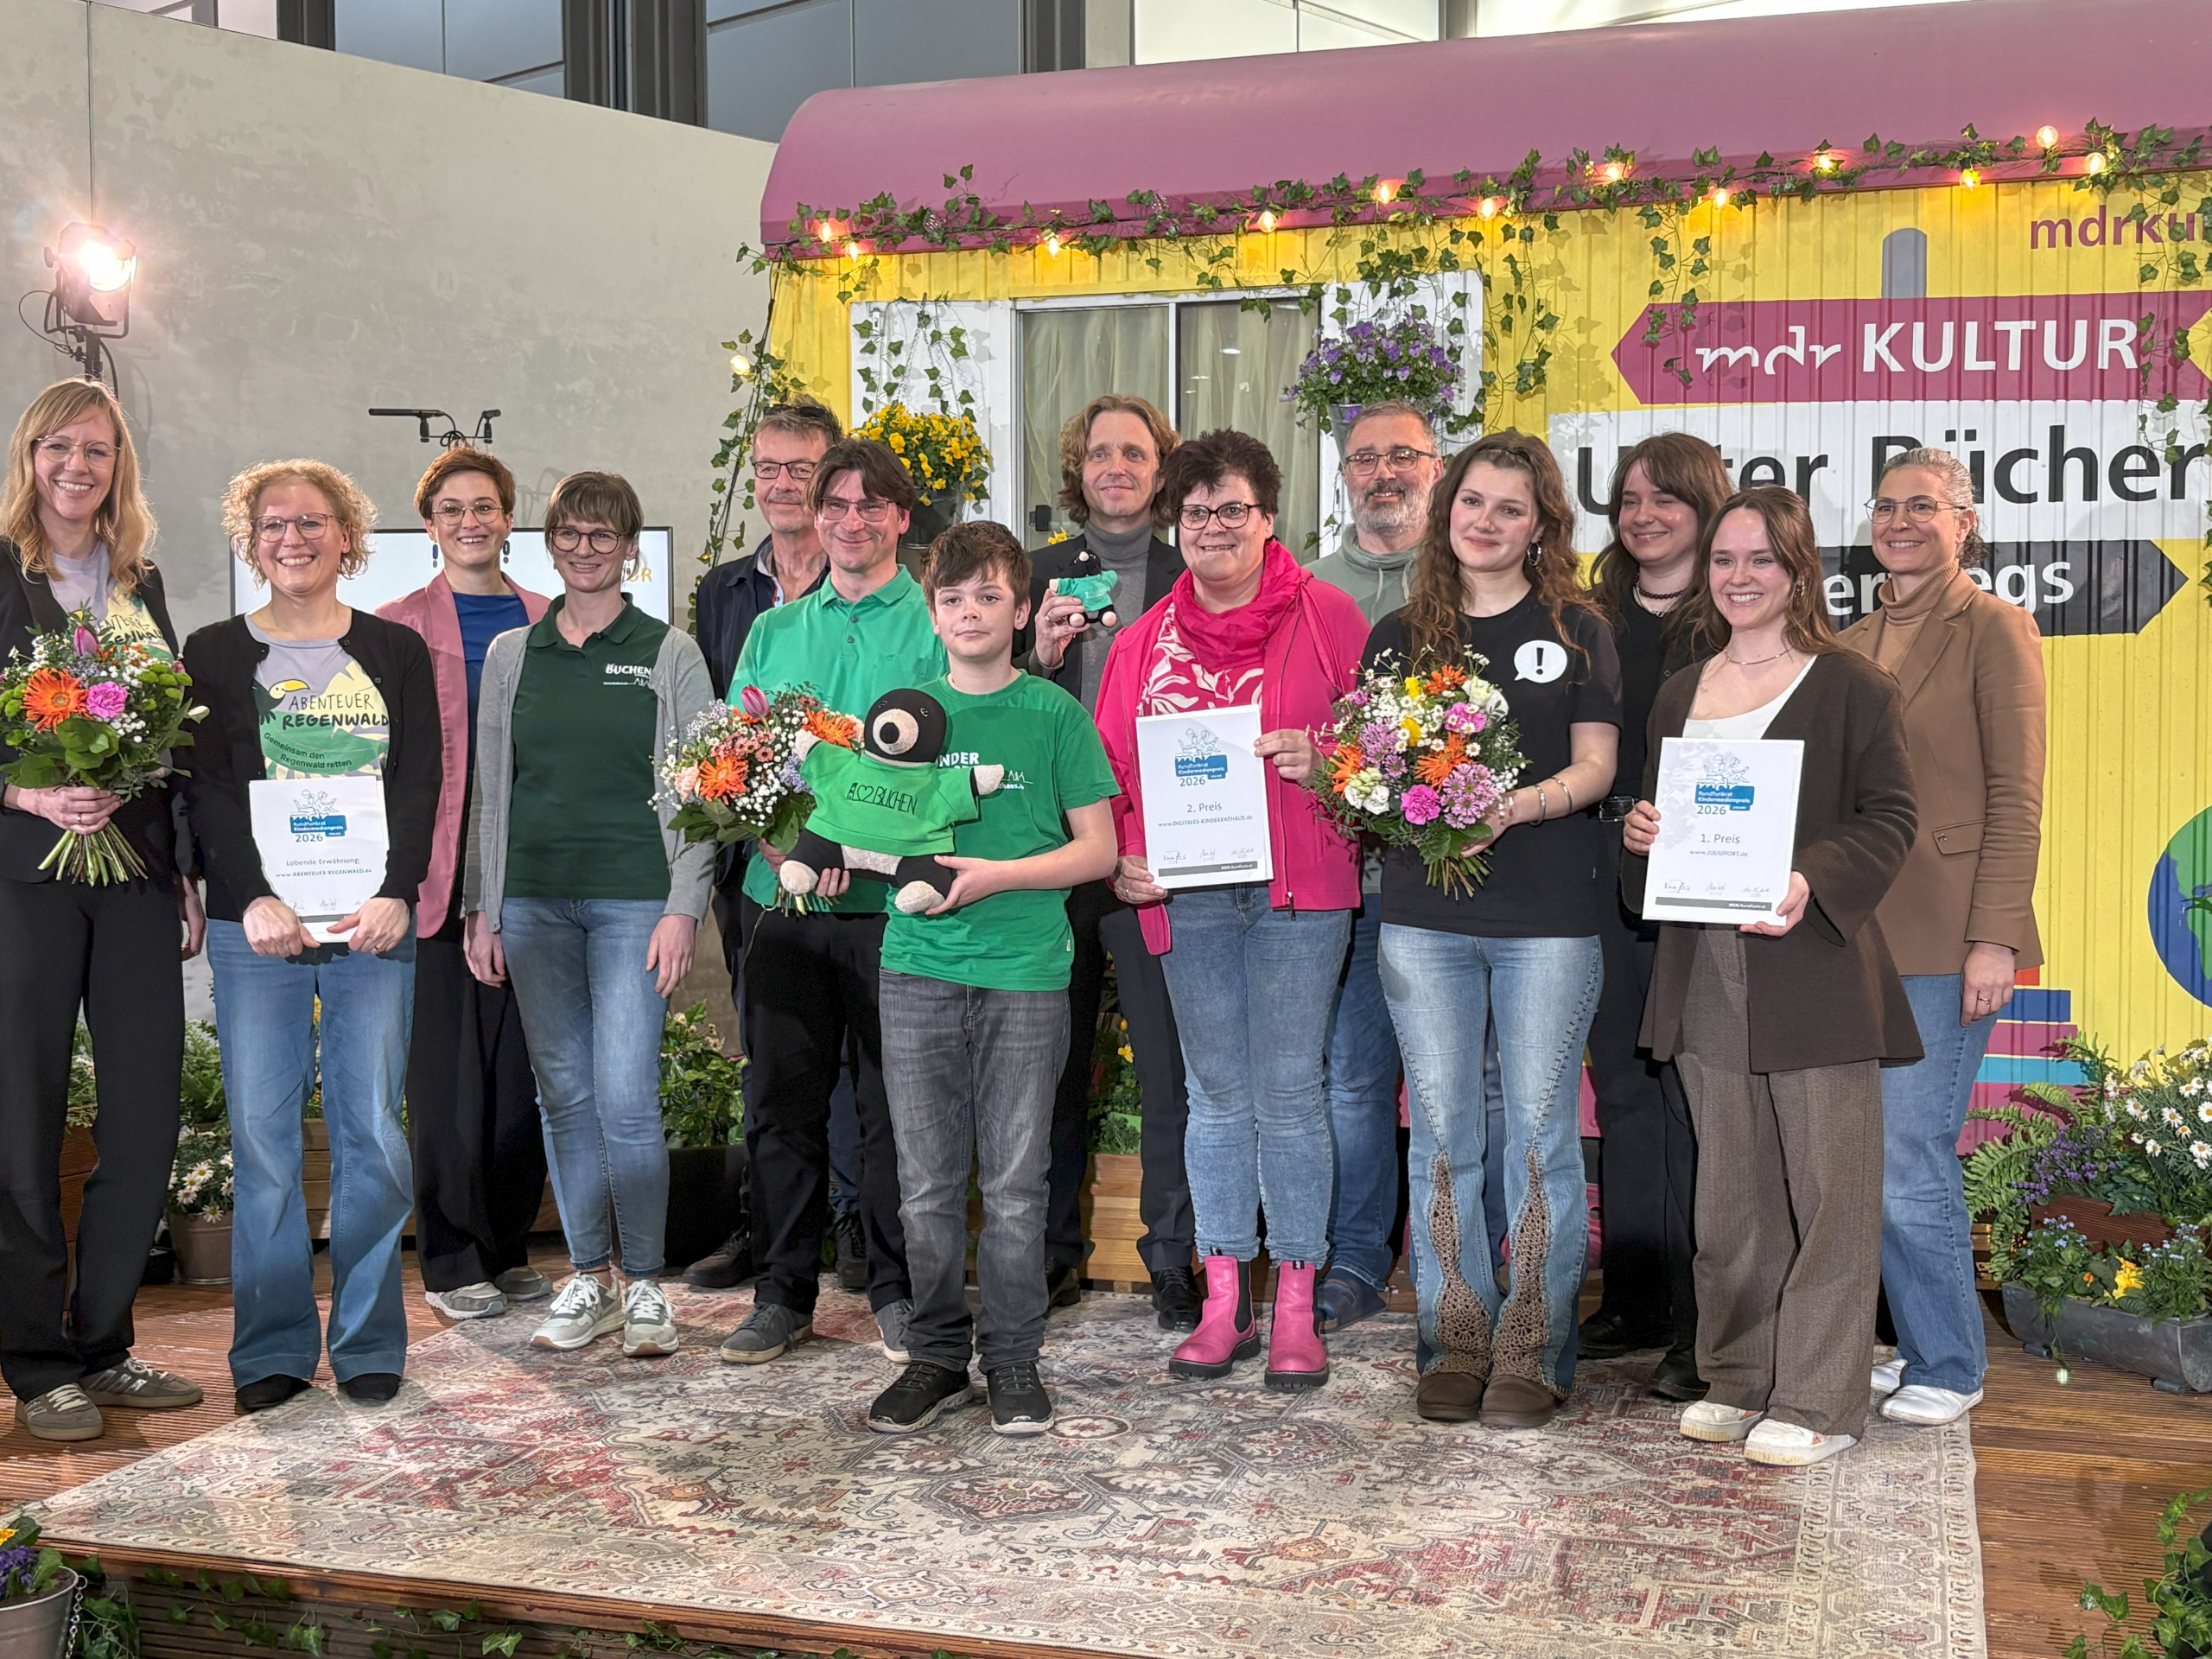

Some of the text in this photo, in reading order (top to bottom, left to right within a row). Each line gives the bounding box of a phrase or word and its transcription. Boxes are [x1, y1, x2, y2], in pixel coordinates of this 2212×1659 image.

[2031, 205, 2206, 249] mdrku
[1695, 319, 2139, 375] mdr KULTUR
[1577, 444, 1828, 515] Uer
[606, 664, 652, 676] BUCHEN
[289, 693, 374, 710] ABENTEUER
[283, 713, 390, 730] REGENWALD
[264, 732, 308, 758] Gemeinsam
[280, 753, 353, 768] Regenwald retten
[939, 751, 979, 767] NDER
[1179, 776, 1205, 787] 2026
[1186, 801, 1222, 813] 2. Preis
[1696, 804, 1726, 815] 2026
[295, 834, 323, 842] 2026
[1700, 833, 1740, 844] 1. Preis
